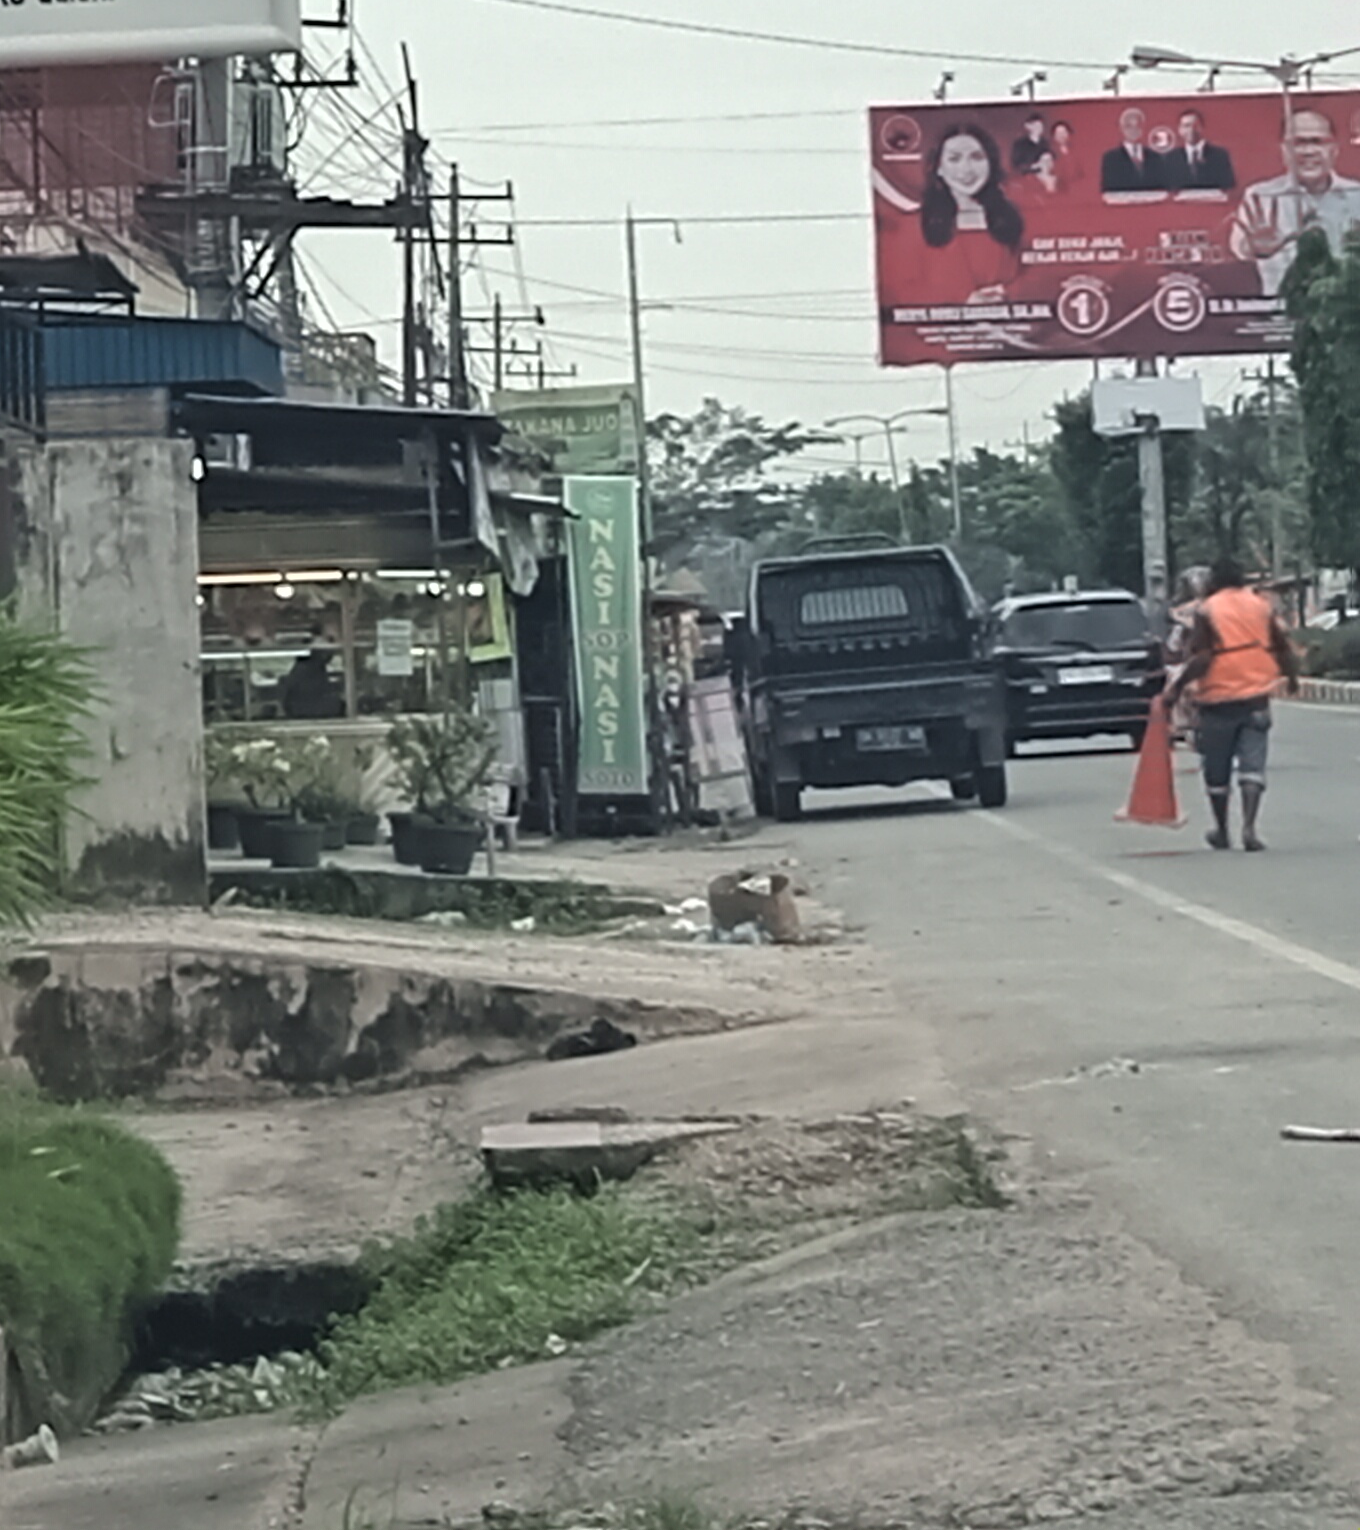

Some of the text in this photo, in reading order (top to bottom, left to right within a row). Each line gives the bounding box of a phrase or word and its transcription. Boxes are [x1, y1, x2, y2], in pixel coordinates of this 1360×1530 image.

[1069, 291, 1091, 326] 1
[1164, 289, 1194, 323] 5
[588, 518, 616, 626] NASI
[592, 654, 620, 765] NASI
